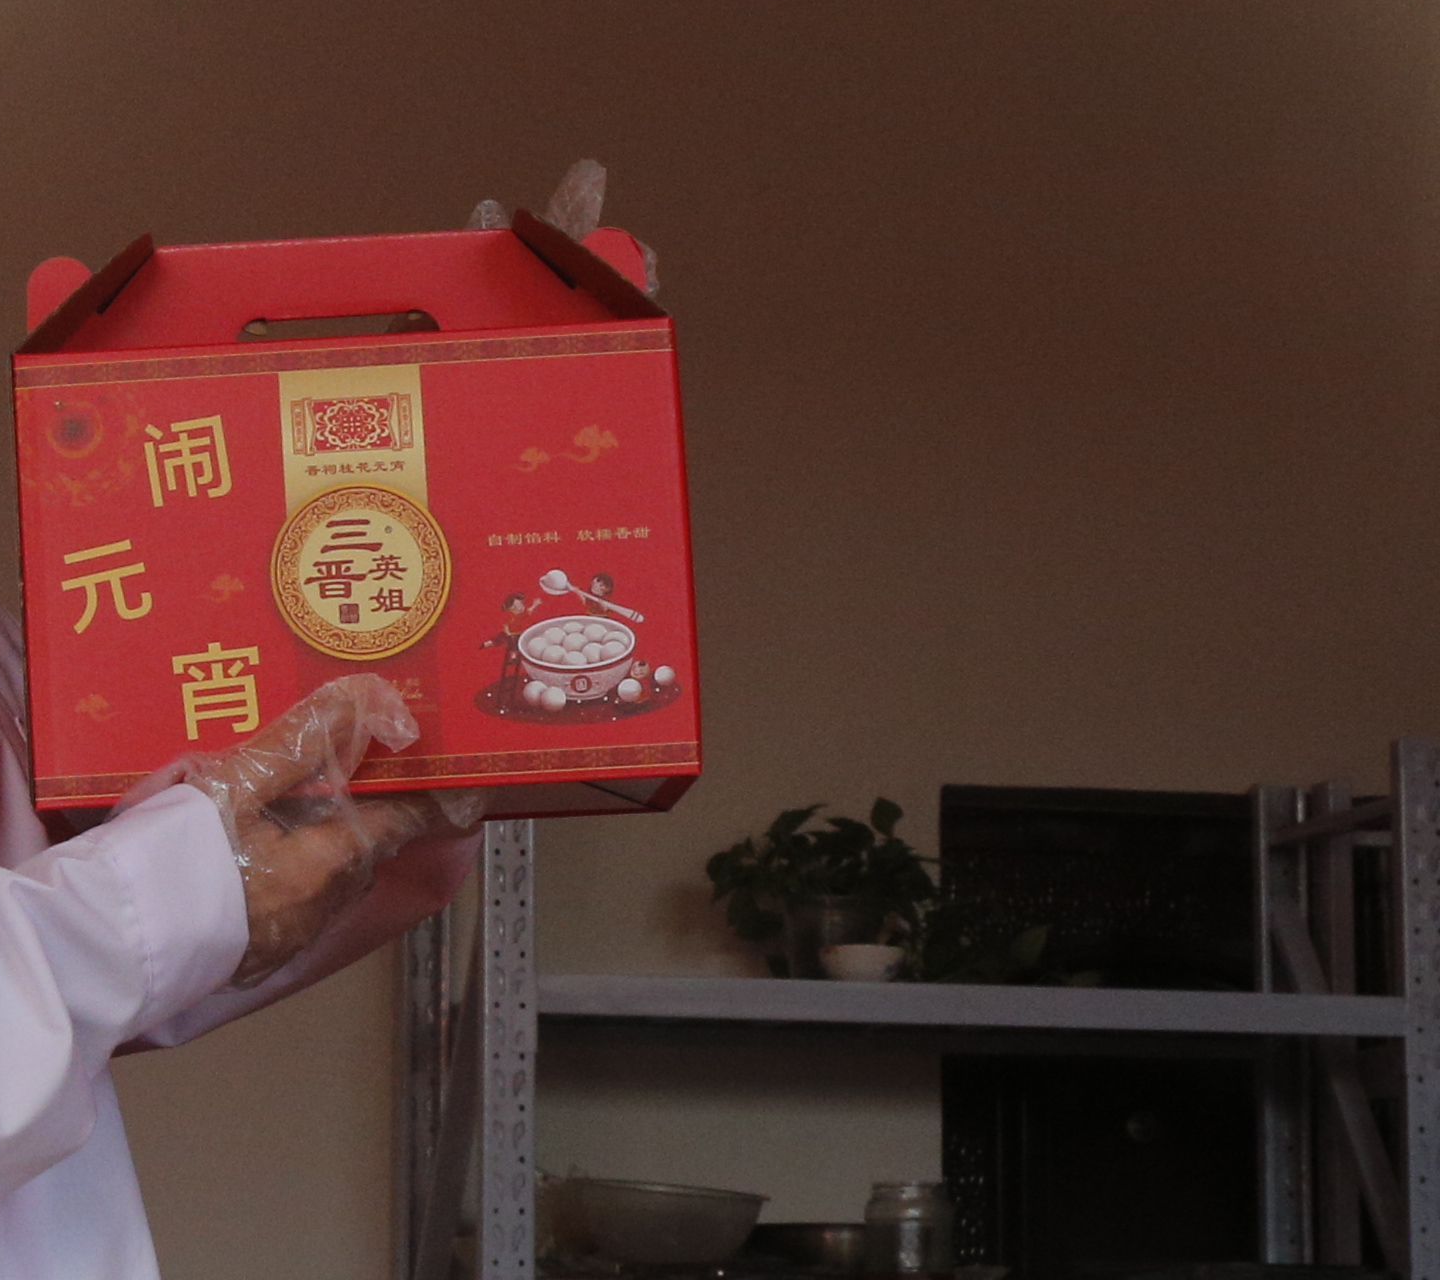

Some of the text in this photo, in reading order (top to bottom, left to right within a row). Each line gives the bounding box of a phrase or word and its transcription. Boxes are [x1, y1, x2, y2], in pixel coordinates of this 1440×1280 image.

[304, 460, 407, 476] 晋祠桂花元宵
[367, 554, 412, 613] 英姐
